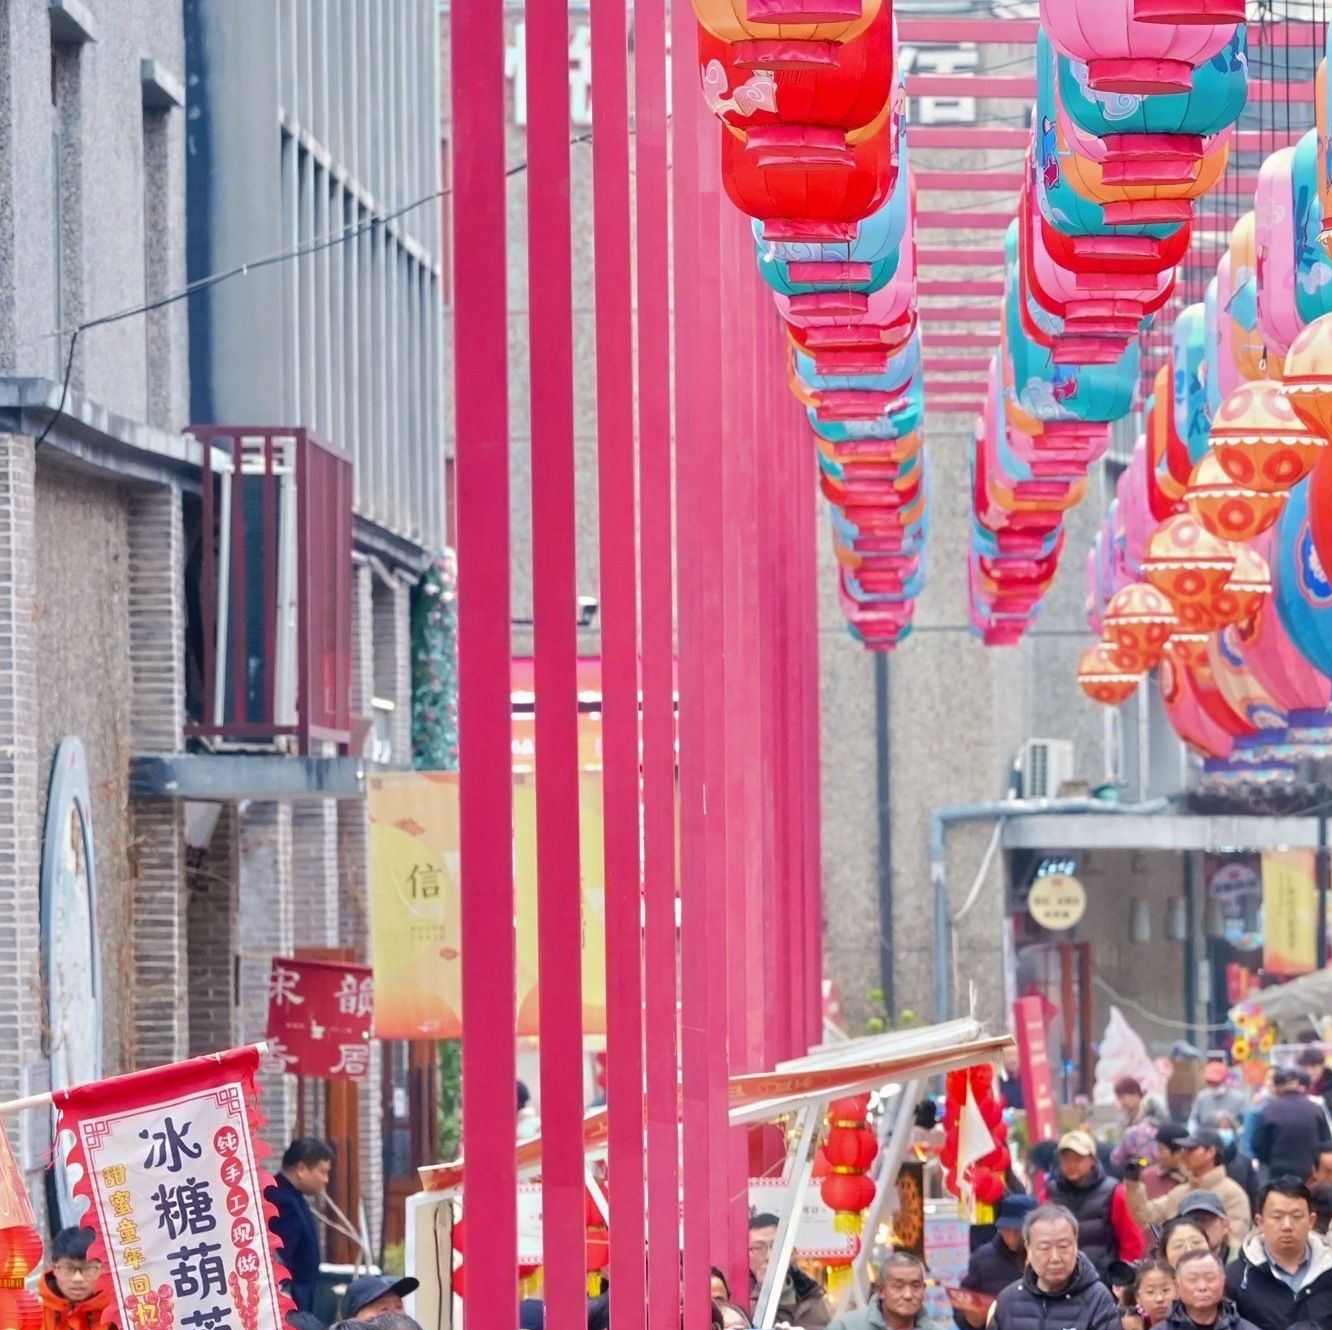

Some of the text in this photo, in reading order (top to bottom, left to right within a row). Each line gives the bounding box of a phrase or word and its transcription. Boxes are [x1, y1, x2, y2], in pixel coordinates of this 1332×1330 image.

[406, 862, 442, 899] 信
[101, 1163, 160, 1326] 甜蜜童年回忆
[215, 1131, 258, 1275] 纯手工现做
